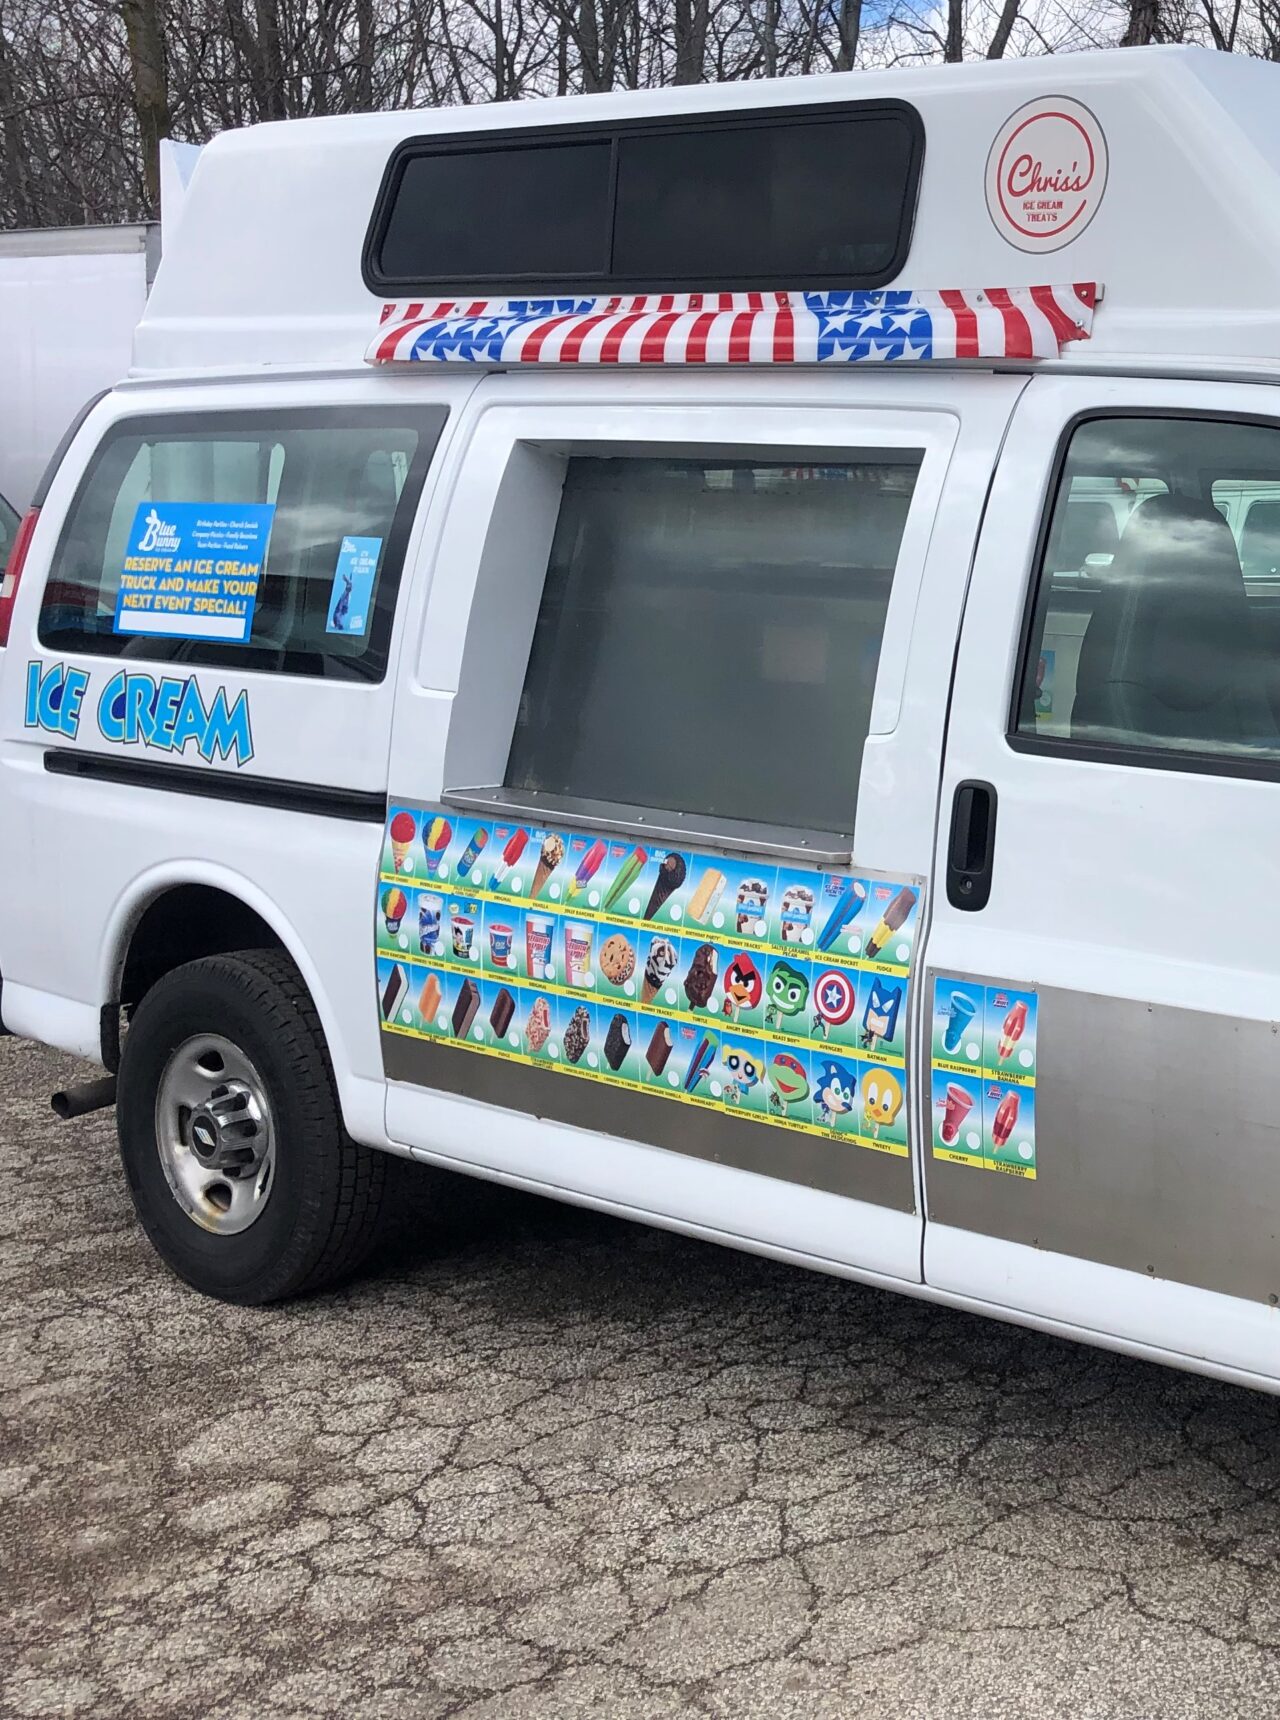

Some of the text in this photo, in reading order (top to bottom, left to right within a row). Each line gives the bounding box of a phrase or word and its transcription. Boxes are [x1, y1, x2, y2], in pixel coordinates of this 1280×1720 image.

[1007, 154, 1084, 197] Chris's
[1023, 201, 1063, 210] ICE CREAM
[1026, 213, 1058, 222] TREATS
[125, 557, 259, 577] RESERVE AN ICE CREAM
[121, 575, 258, 597] TRUCK AND MAKE YOUR
[122, 594, 247, 615] NEXT EVENT SPECIAL!
[24, 660, 255, 768] ICE CREAM
[576, 910, 595, 918] RANCHER
[605, 916, 634, 925] WATERMELON
[640, 922, 664, 931] CHOCOLATE
[686, 930, 705, 938] BIRTHDAY
[728, 939, 743, 947] BUNNY
[771, 944, 809, 955] SALTED CARAMEL
[823, 955, 839, 963] CREAM
[840, 958, 858, 967] ROCKET
[876, 964, 892, 973] FUDGE
[566, 989, 587, 998] LEMONADE
[602, 997, 613, 1005] CHIPS
[641, 1005, 656, 1013] BUNNY
[692, 1016, 708, 1024] TURTLE
[726, 1025, 741, 1033] ANGRY
[772, 1034, 788, 1042] BEAST
[819, 1044, 843, 1053] AVENGERS
[866, 1053, 887, 1062] BATMAN
[950, 1064, 977, 1074] RASPBERRY
[991, 1069, 1026, 1081] STRAWBERRY
[997, 1076, 1020, 1085] BANANA
[725, 1106, 752, 1118] POWERPUFF
[831, 1134, 857, 1144] HEDGEHOG
[872, 1142, 891, 1151] TWEETY
[949, 1153, 968, 1162] CHERRY
[993, 1160, 1027, 1172] STRAWBERRY
[995, 1166, 1025, 1177] RASPBERRY
